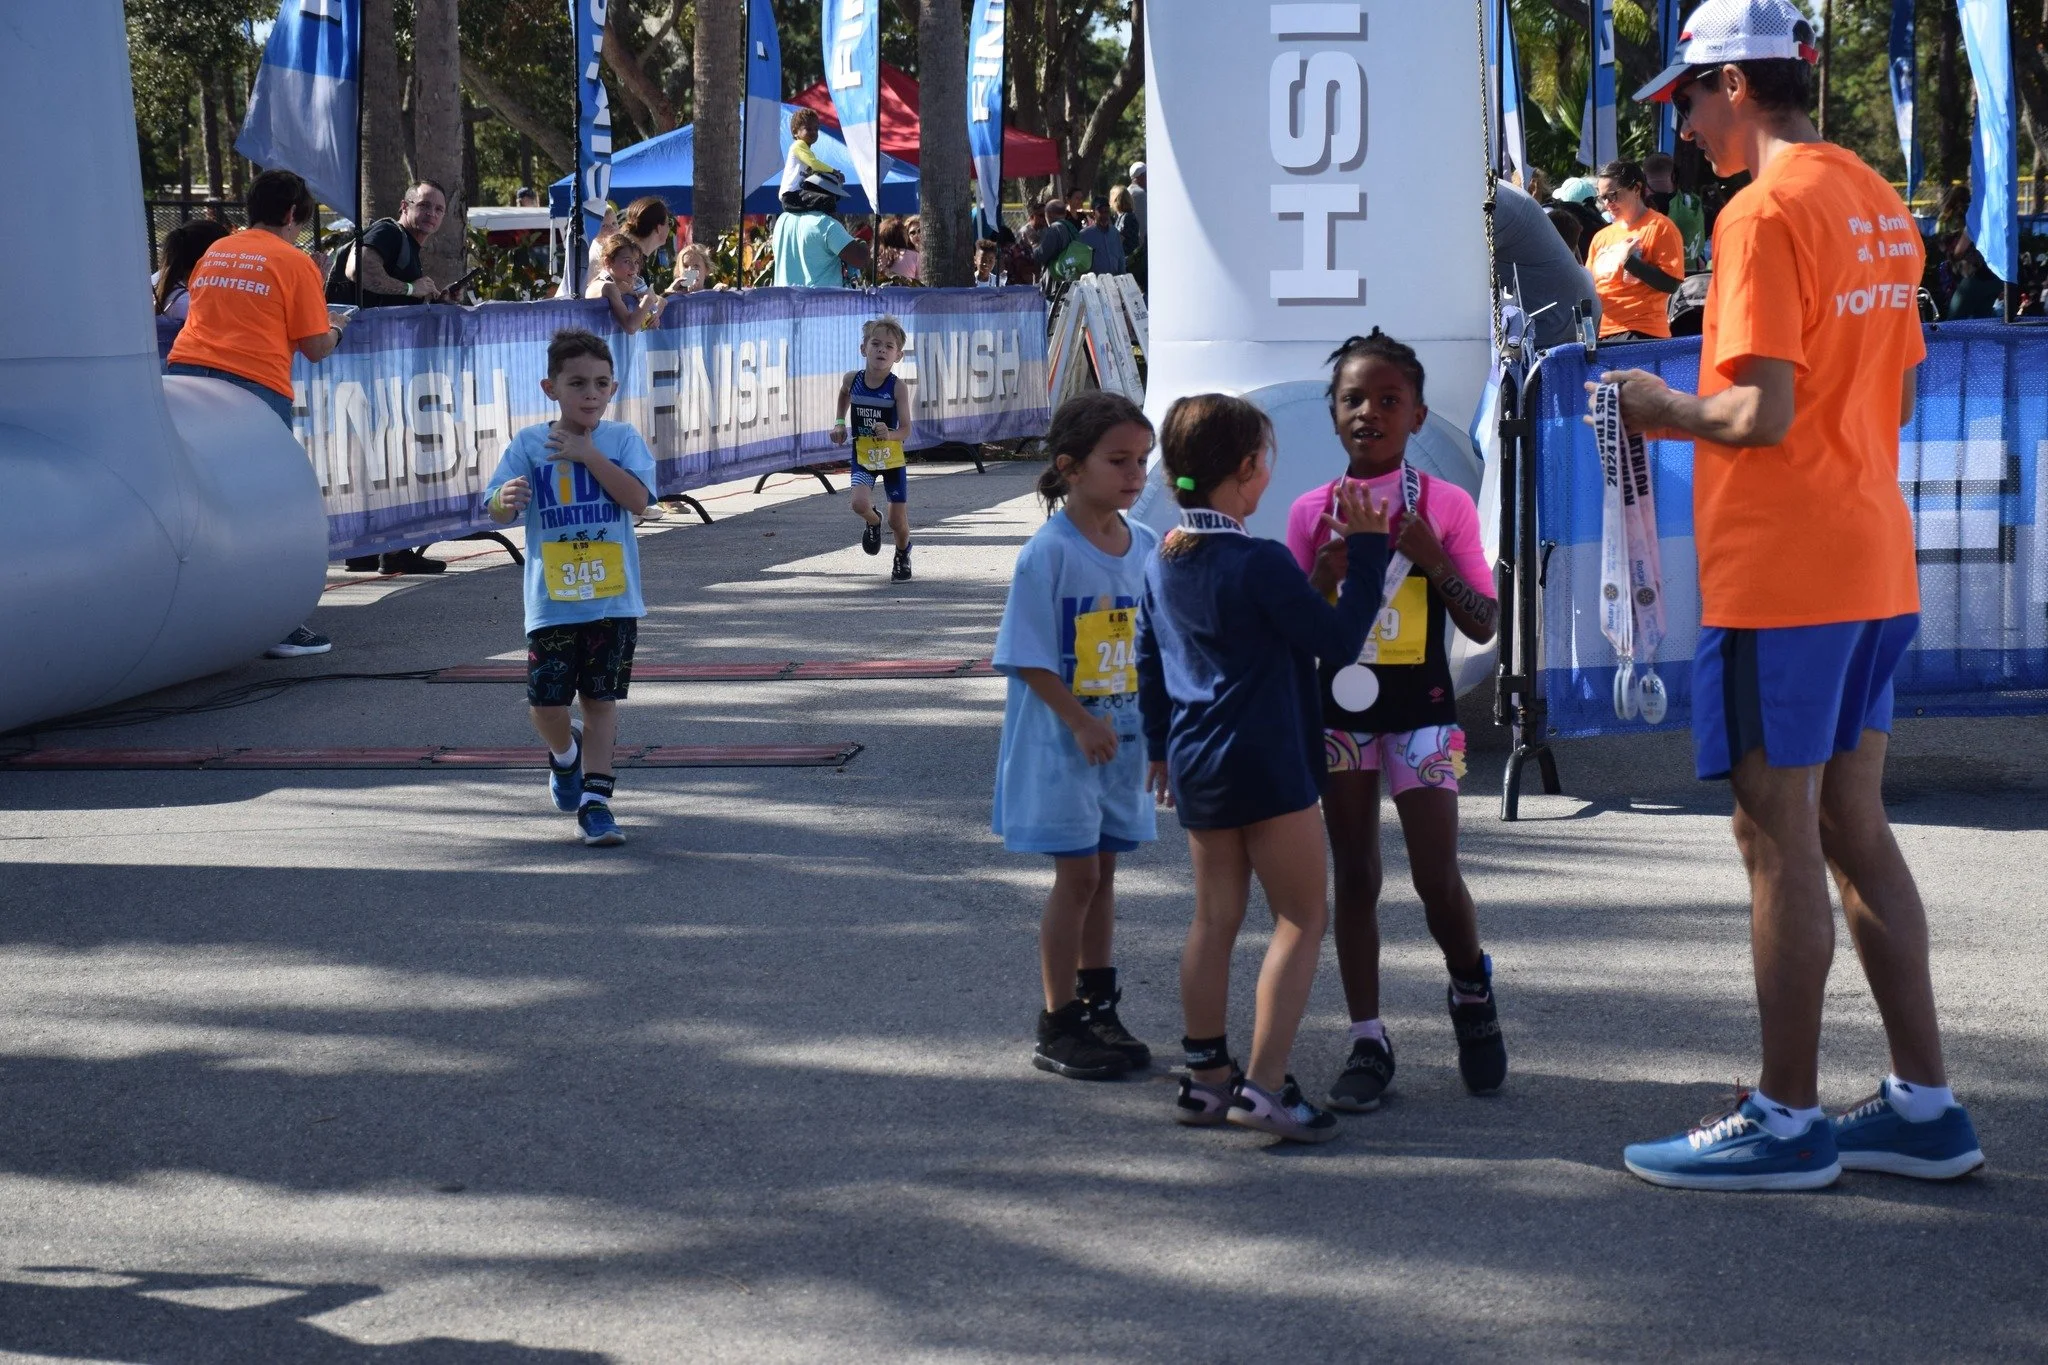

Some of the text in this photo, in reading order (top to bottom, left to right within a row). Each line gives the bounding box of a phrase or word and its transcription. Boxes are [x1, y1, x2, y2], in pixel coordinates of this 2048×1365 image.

[238, 262, 254, 270] am
[239, 253, 267, 263] Smile
[647, 338, 789, 443] FINISH
[856, 407, 882, 418] TRISTAN
[867, 447, 891, 462] 373
[1607, 446, 1618, 487] 2024
[540, 503, 621, 530] TRIATHLON
[561, 558, 606, 586] 345
[1607, 603, 1615, 629] Rotary
